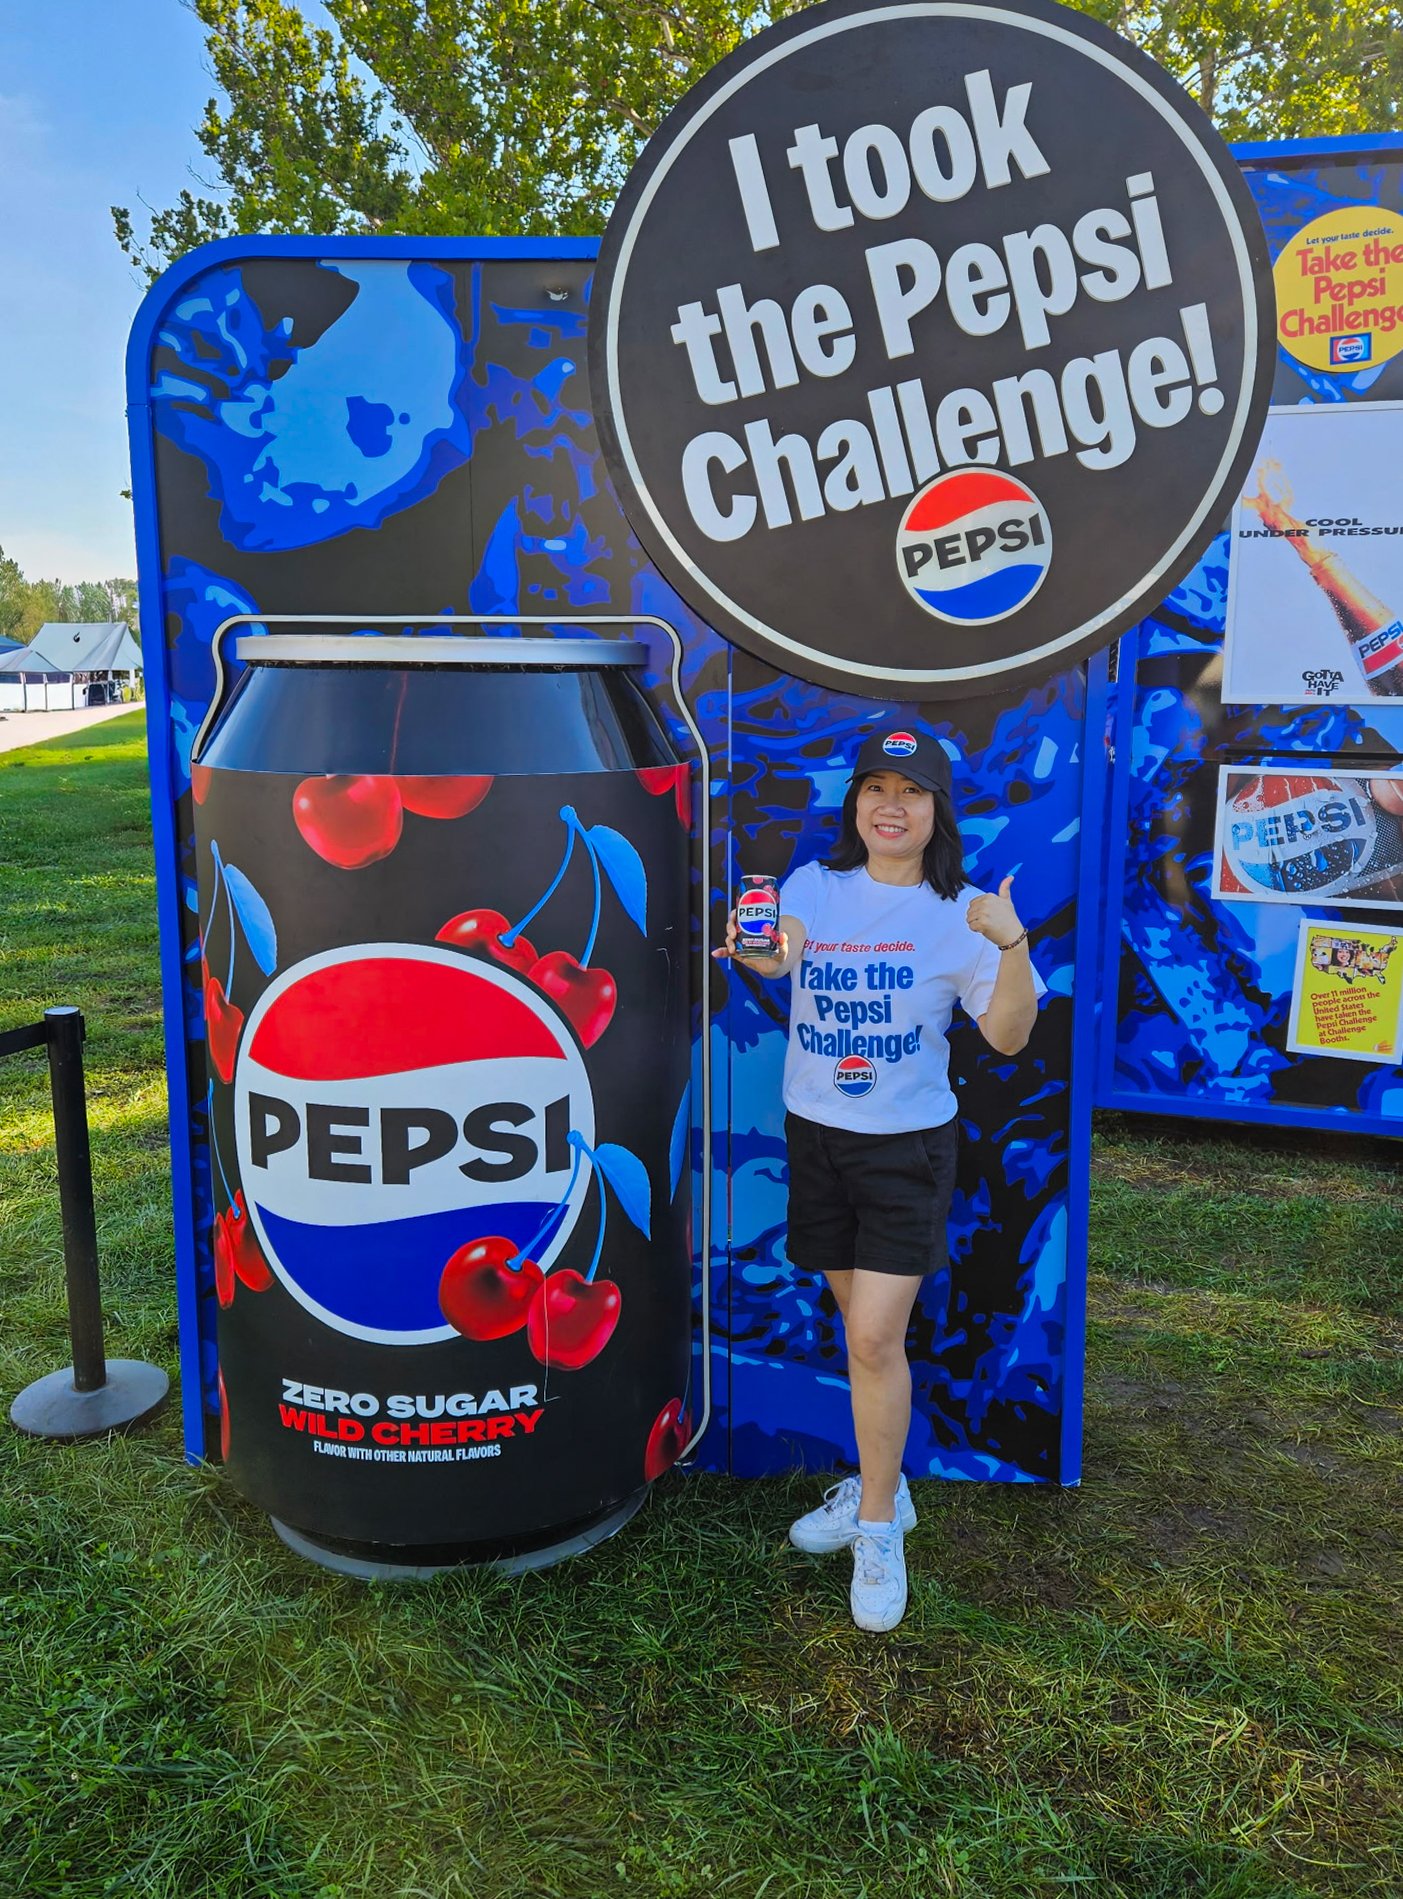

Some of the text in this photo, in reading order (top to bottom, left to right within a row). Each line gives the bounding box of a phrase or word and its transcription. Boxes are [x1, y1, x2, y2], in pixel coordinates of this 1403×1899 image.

[728, 69, 1051, 252] I took
[1306, 227, 1394, 245] Let your taste decide.
[1296, 237, 1403, 277] Take the
[670, 171, 1174, 406] the Pepsi
[1314, 267, 1387, 306] Pepsi
[1338, 345, 1363, 354] PEPSI
[681, 302, 1226, 542] Challenge!
[1306, 518, 1362, 527] COOL
[1239, 527, 1403, 538] UNDER PRESSU
[901, 517, 1046, 579] PEPSI
[1302, 669, 1344, 682] GOTTA
[1308, 680, 1340, 690] HAVE
[1316, 687, 1333, 697] IT
[885, 740, 916, 751] PEPSI
[1231, 798, 1367, 851] PEPSI
[739, 907, 776, 918] PEPSI
[814, 941, 839, 954] your
[840, 942, 871, 953] taste
[873, 940, 916, 952] decide.
[800, 959, 914, 991] Take the
[1310, 992, 1330, 1000] Over
[1339, 986, 1367, 996] million
[1312, 991, 1380, 1008] people across the
[813, 993, 892, 1031] Pepsi
[1313, 1002, 1364, 1015] United States
[1314, 1008, 1372, 1022] have taken the
[1316, 1015, 1377, 1030] Pepsi Challenge
[1327, 1025, 1367, 1036] Challenge
[796, 1022, 923, 1064] Challenge!
[1319, 1035, 1350, 1045] Booths.
[836, 1071, 873, 1082] PEPSI
[248, 1090, 572, 1186] PEPSI
[281, 1377, 539, 1419] ZERO SUGAR
[278, 1403, 545, 1446] WILD CHERRY
[313, 1439, 502, 1463] FLAVOR WITH OTHER NATURAL FLAVORS
